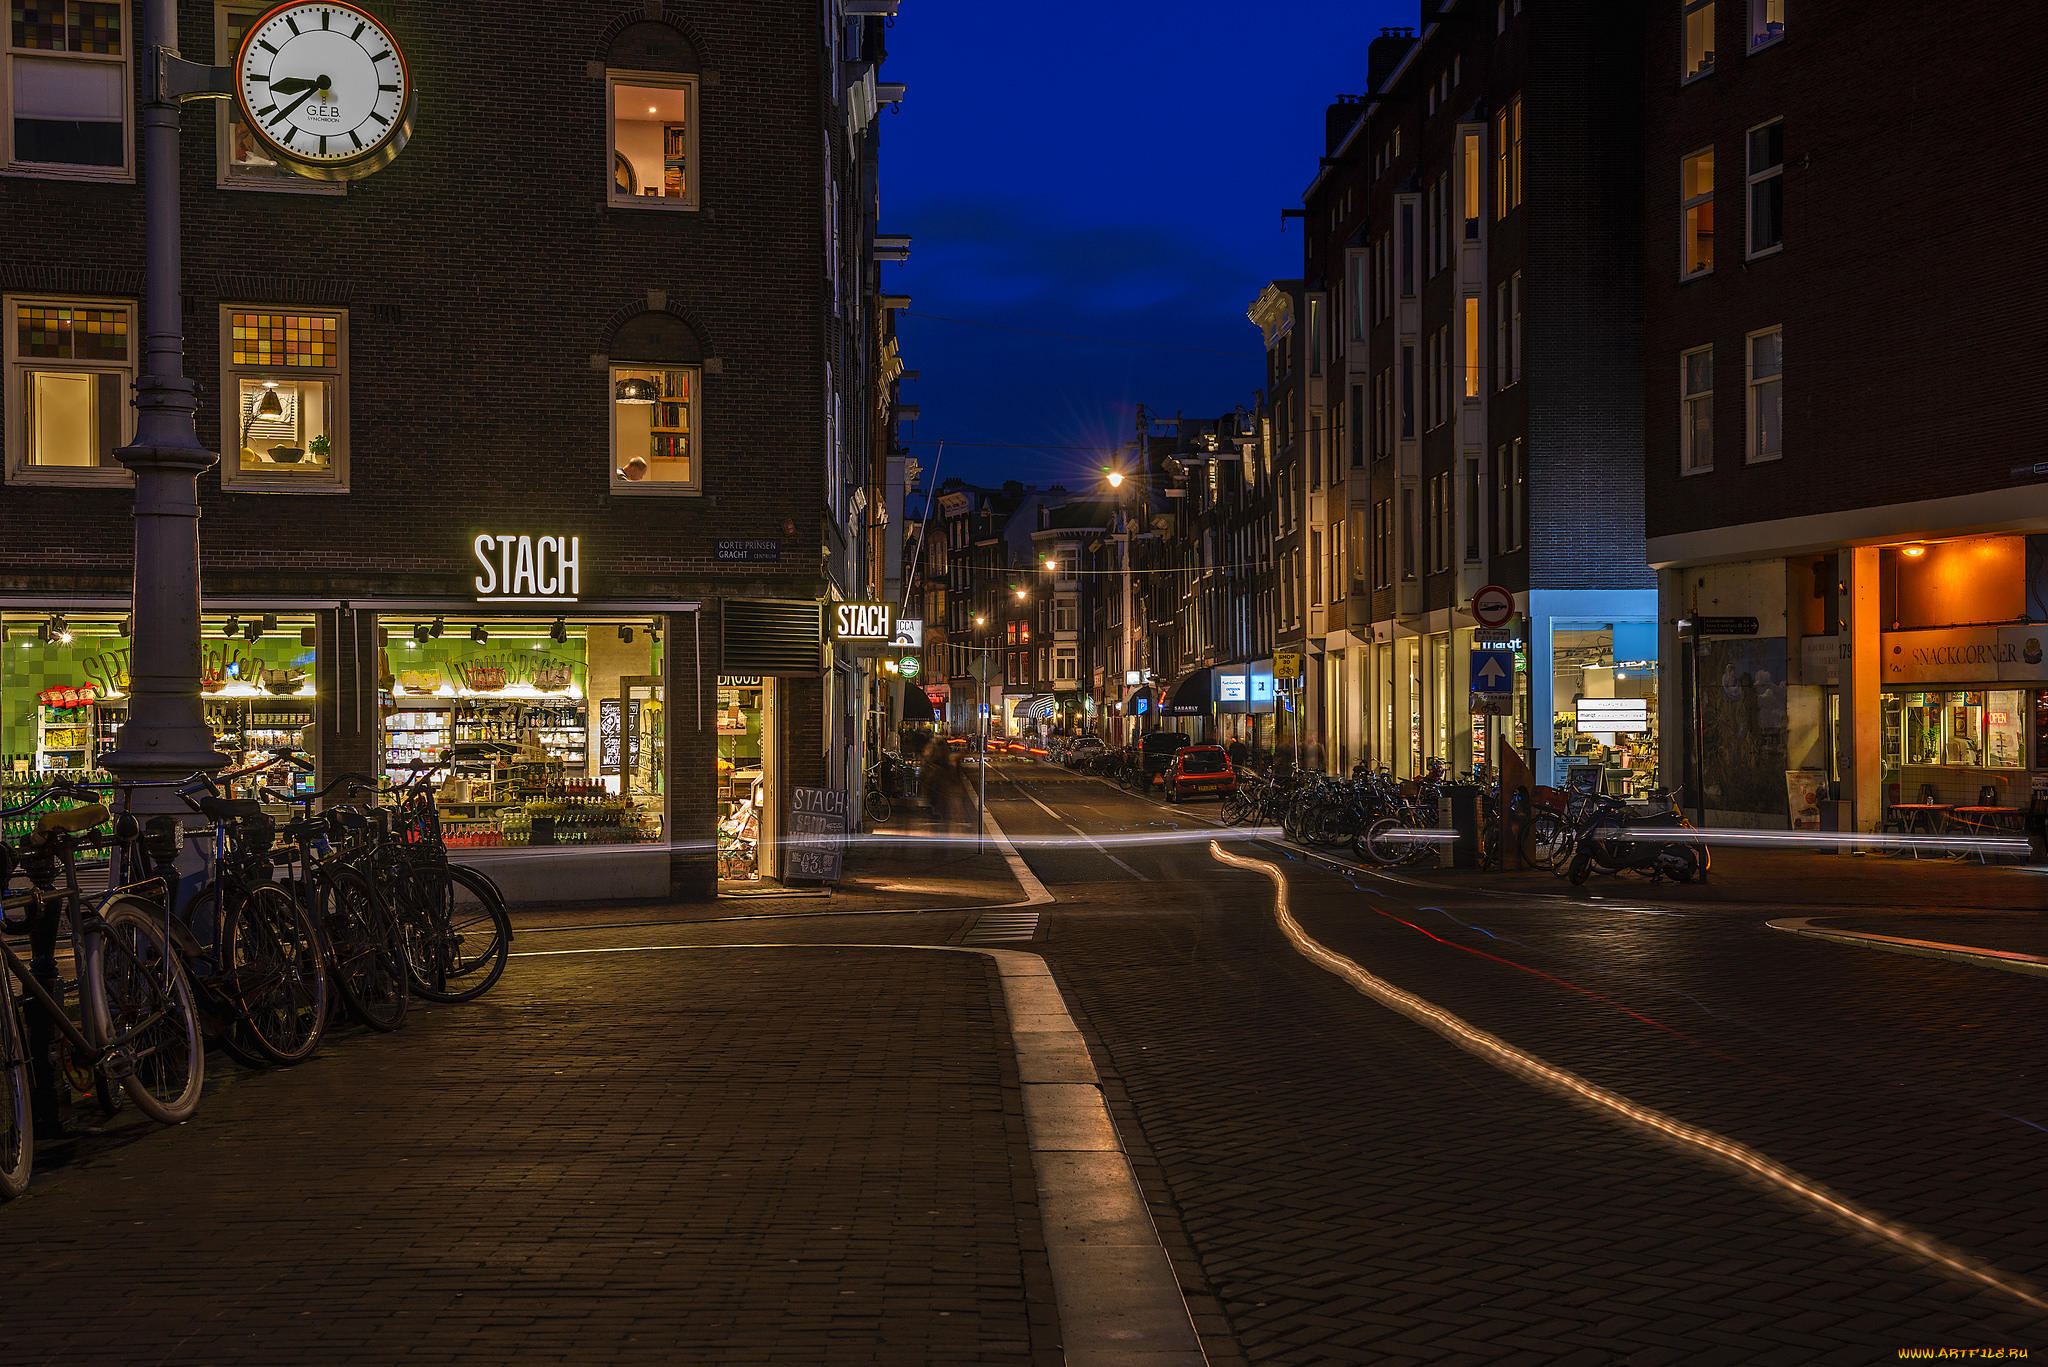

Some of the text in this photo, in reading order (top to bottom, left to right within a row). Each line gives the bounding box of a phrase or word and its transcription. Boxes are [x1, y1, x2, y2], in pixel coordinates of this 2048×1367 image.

[306, 105, 341, 118] G.E.B.
[718, 541, 776, 550] KORTE PRINSEN
[718, 550, 748, 558] GRACHT
[474, 534, 580, 595] STACH
[837, 605, 889, 636] STACH
[1912, 643, 2017, 666] SNACKCORNER
[1988, 712, 2007, 724] OPEN
[794, 788, 845, 814] STACH
